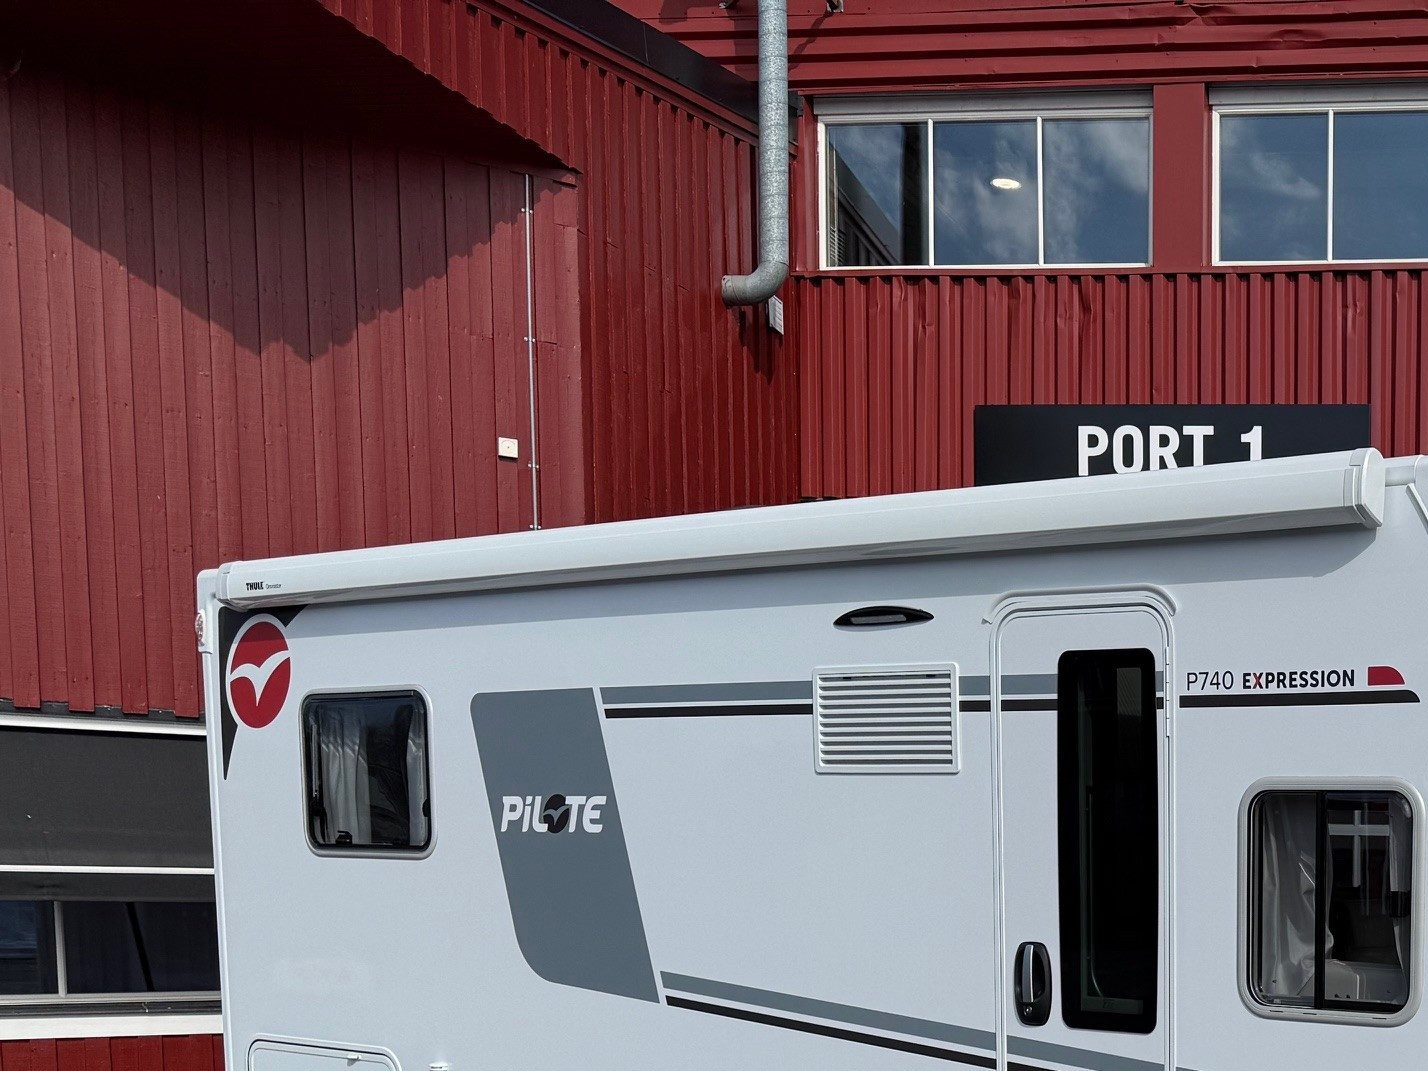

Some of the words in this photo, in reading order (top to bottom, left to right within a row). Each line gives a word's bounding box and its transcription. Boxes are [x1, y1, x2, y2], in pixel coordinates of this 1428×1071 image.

[1077, 424, 1214, 476] PORT
[1240, 425, 1263, 461] 1
[246, 581, 264, 591] THULE
[1186, 670, 1234, 691] P740
[1242, 669, 1355, 690] EXPRESSION
